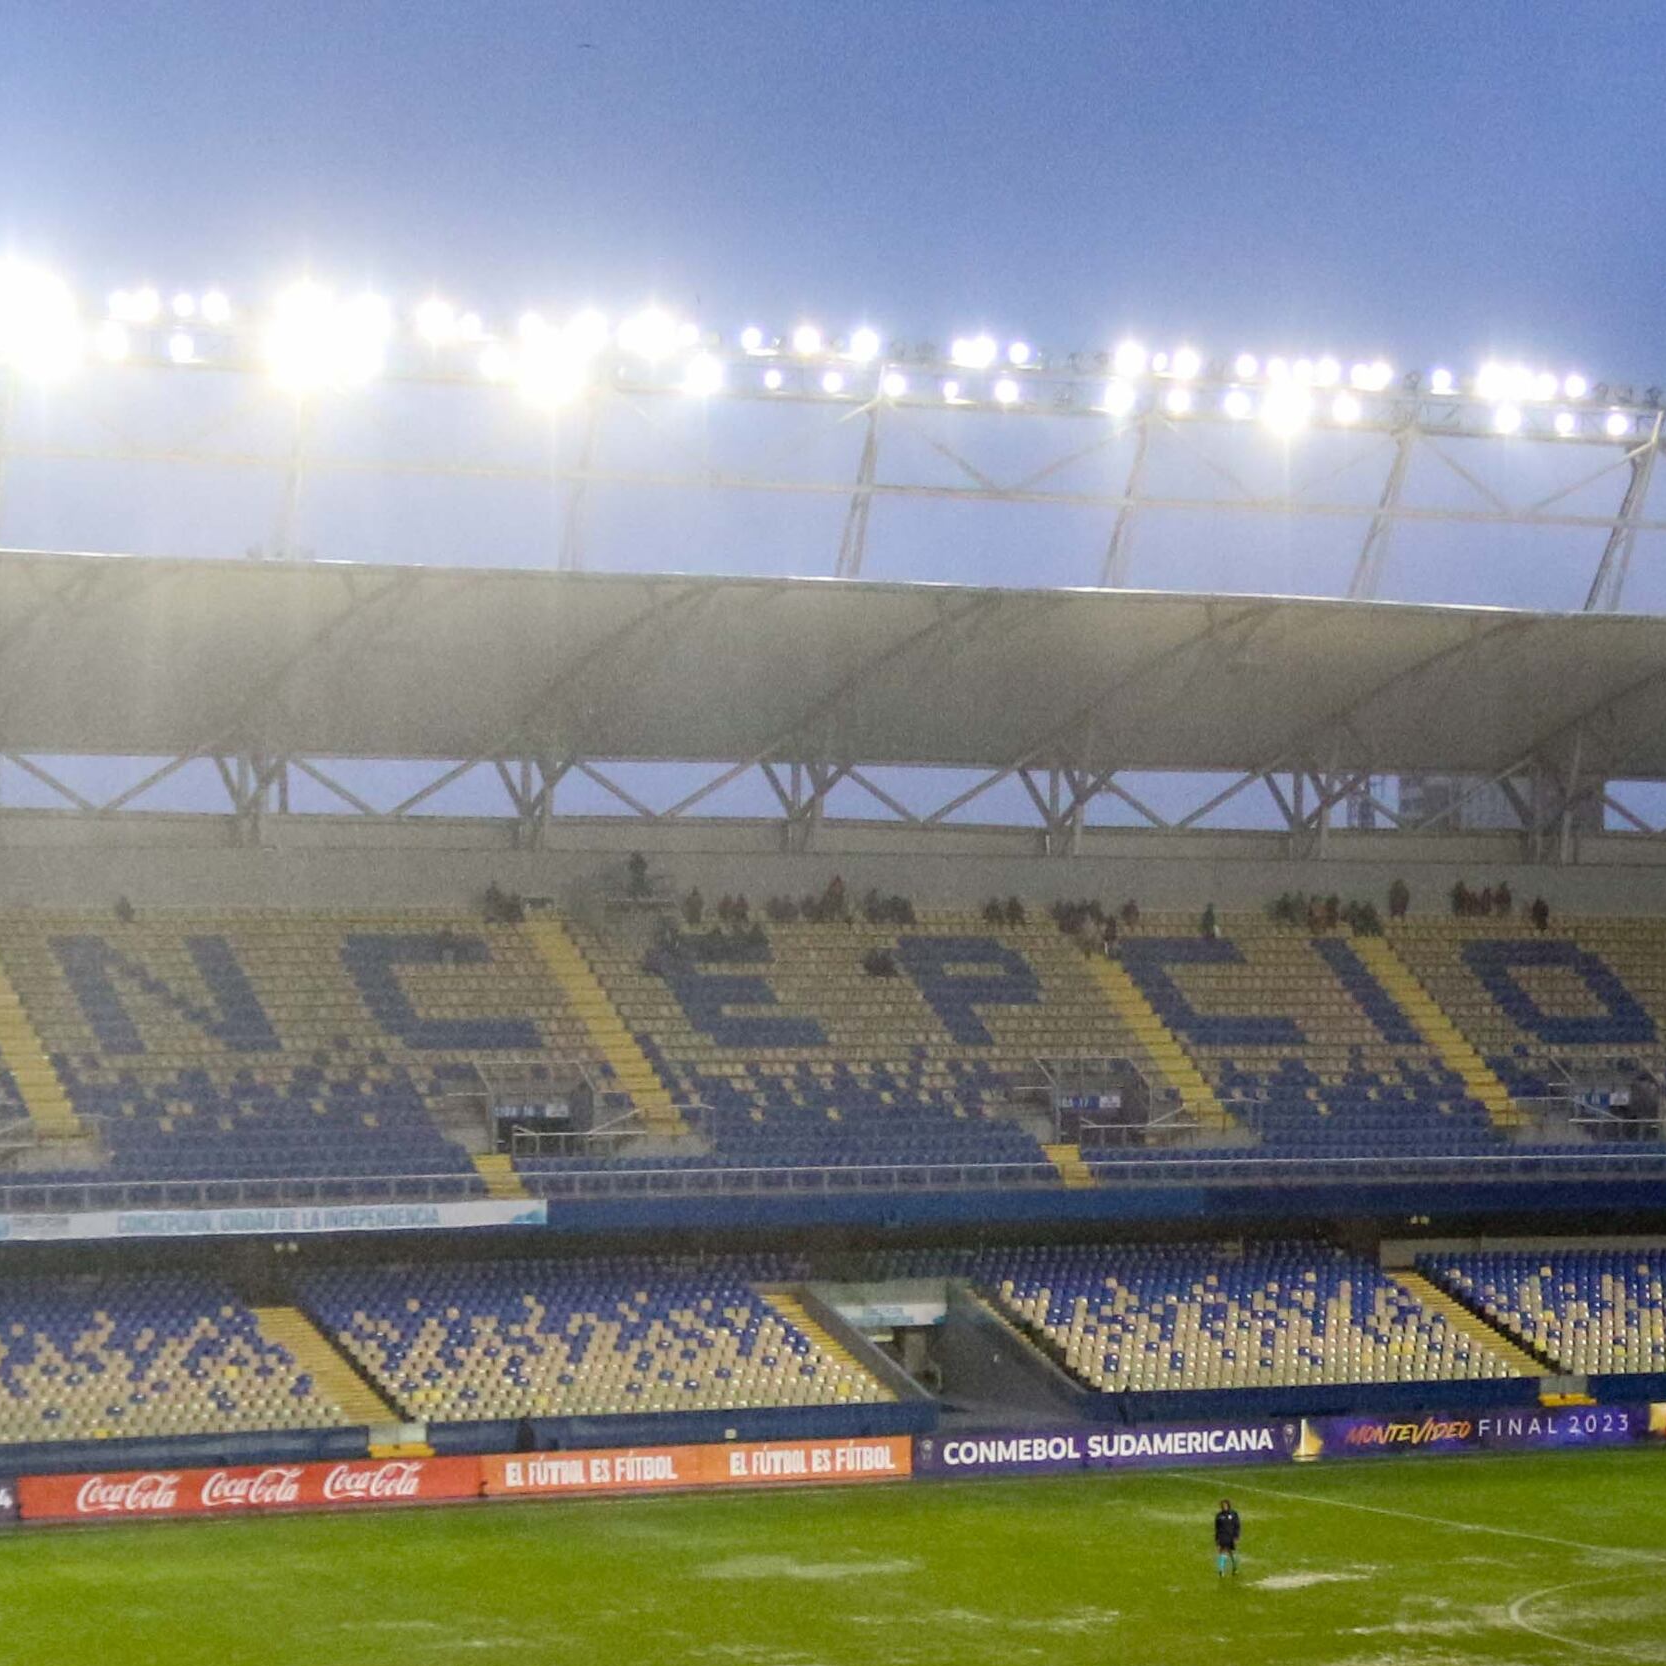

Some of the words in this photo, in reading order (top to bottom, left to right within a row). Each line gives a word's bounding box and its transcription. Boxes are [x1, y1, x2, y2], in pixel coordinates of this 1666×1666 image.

[943, 1436, 1080, 1465] CONMEBOL
[1087, 1428, 1273, 1458] SUDAMERICANA
[1345, 1417, 1471, 1445] MONTEVIDEO
[1479, 1418, 1558, 1437] FINAL
[1568, 1414, 1629, 1435] 2023
[505, 1463, 524, 1487] EL
[590, 1460, 611, 1484] ES
[614, 1451, 678, 1482] FÚTBOL
[730, 1452, 747, 1476] EL
[811, 1450, 831, 1473] ES
[835, 1440, 896, 1472] FÚTBOL
[76, 1474, 183, 1512] Coca-Cola
[201, 1467, 305, 1506] Coca-Cola
[322, 1461, 425, 1499] Coca-Cola
